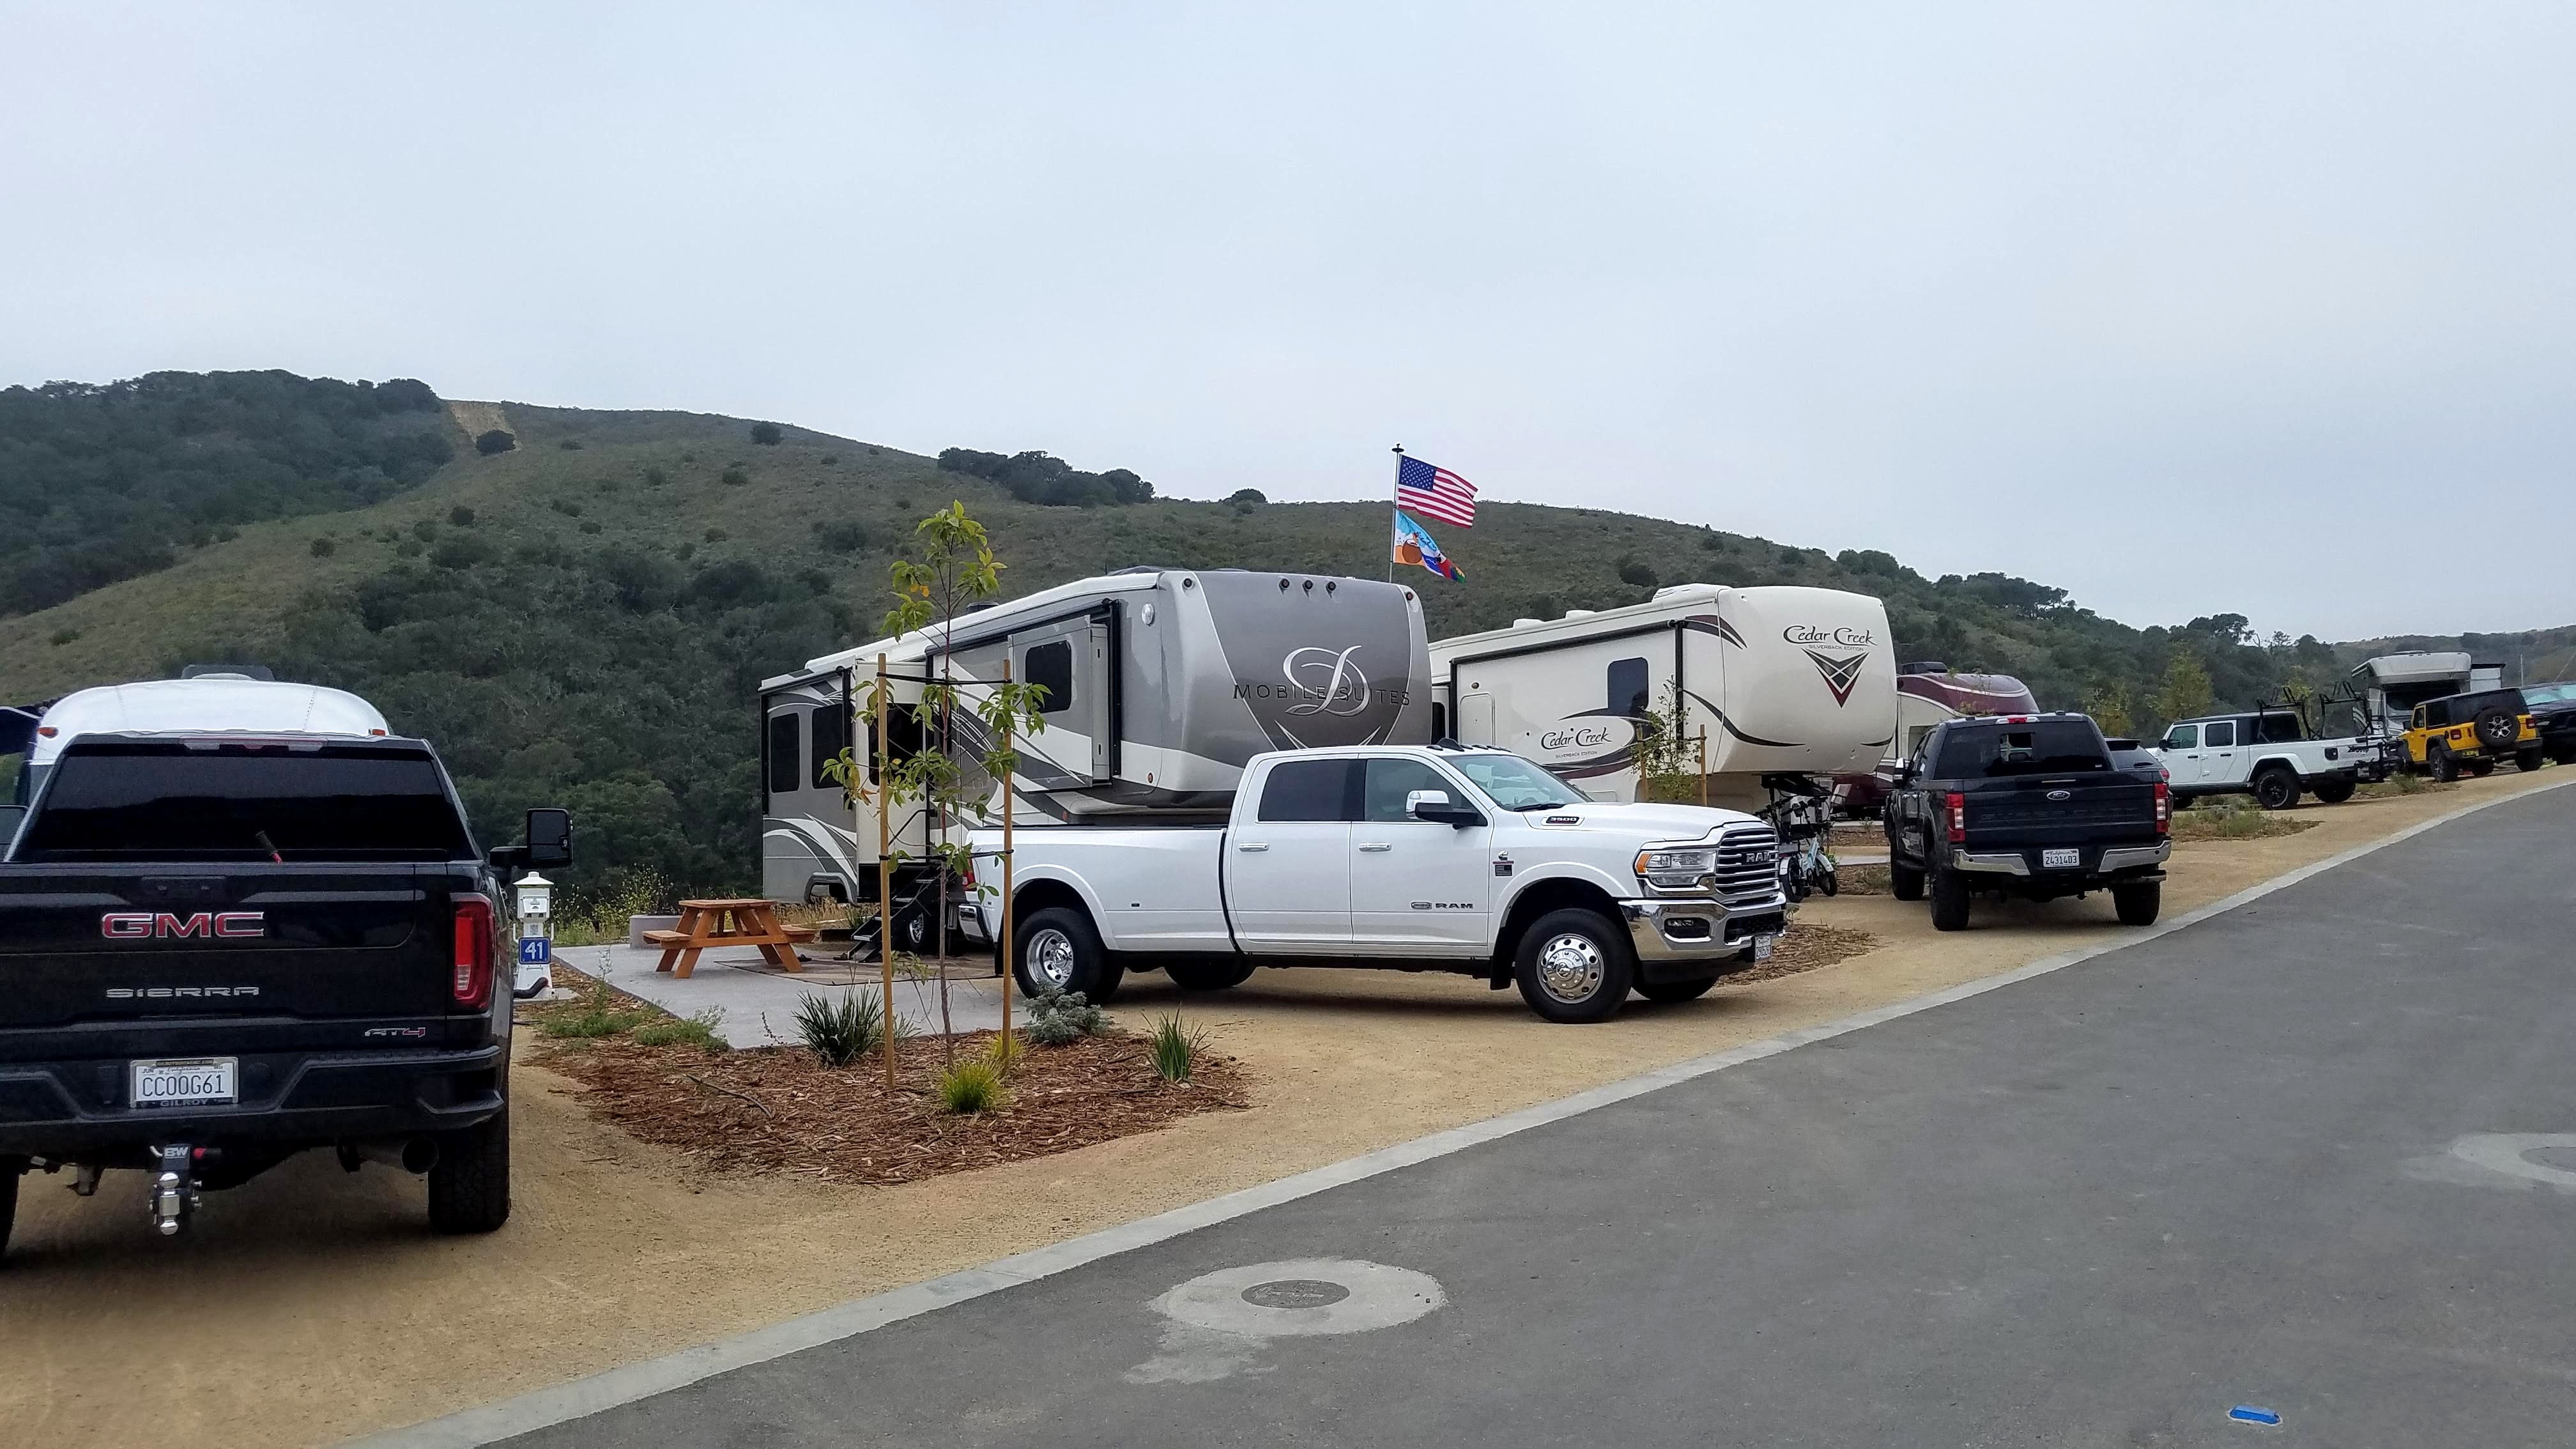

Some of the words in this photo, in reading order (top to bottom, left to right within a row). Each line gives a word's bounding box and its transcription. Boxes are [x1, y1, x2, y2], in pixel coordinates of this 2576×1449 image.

[1783, 625, 1830, 644] Cedar
[1834, 627, 1878, 646] Creek
[1232, 684, 1327, 701] MOBILE
[1338, 687, 1411, 706] SUITES
[1540, 731, 1574, 750] Cedar
[1575, 726, 1613, 746] Creek
[2046, 855, 2077, 865] 24314D3
[102, 912, 264, 938] GMC
[525, 941, 543, 960] 41
[105, 986, 259, 998] SIERRA
[364, 1027, 426, 1038] AT4
[160, 1098, 208, 1107] GILROY
